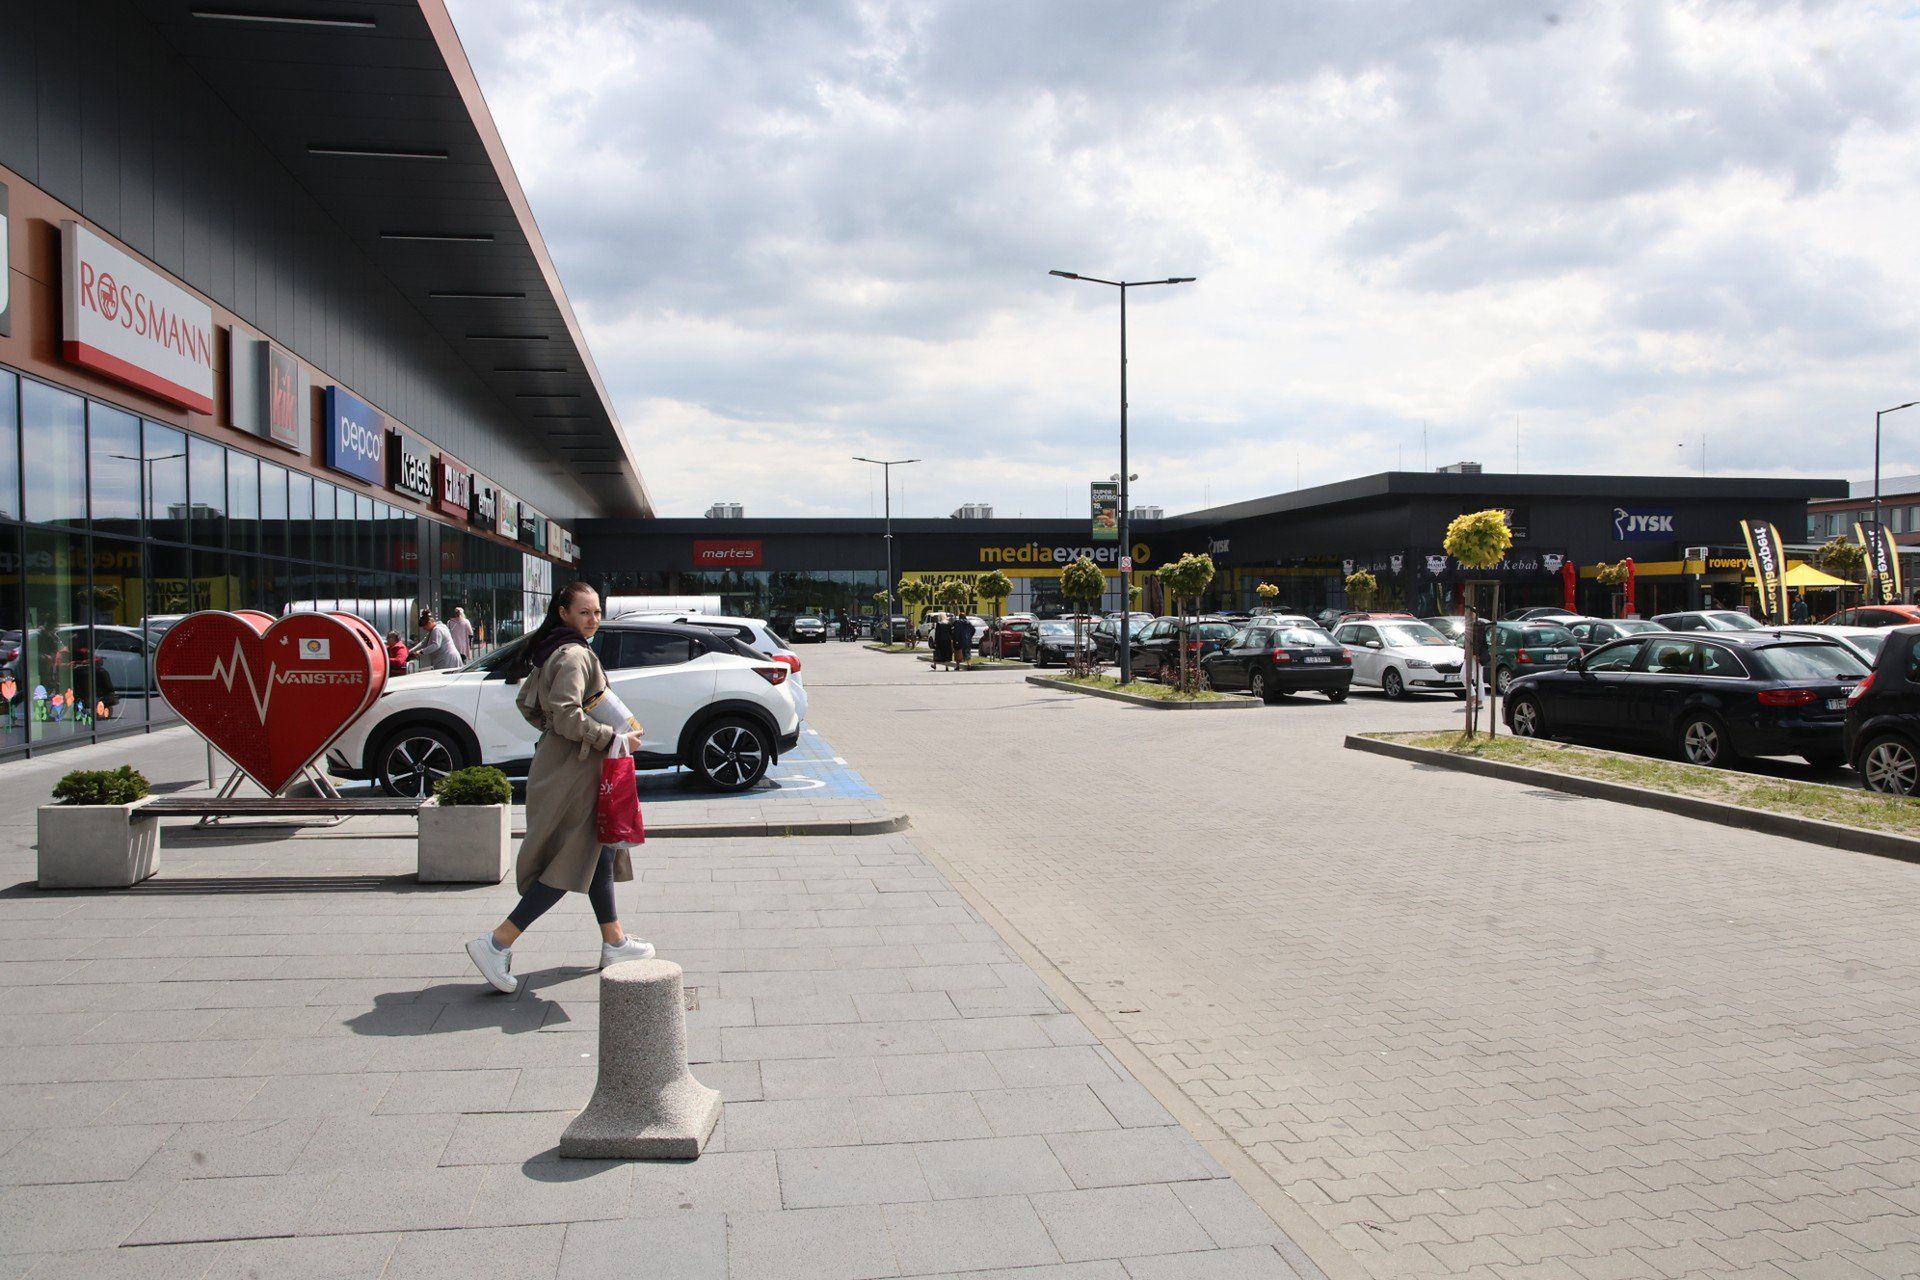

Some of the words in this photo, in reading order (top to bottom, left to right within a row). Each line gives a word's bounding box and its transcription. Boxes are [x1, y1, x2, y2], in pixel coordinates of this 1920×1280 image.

[80, 260, 211, 369] ROSSMANN
[1627, 515, 1675, 532] JYSK
[702, 548, 754, 558] martes
[1503, 560, 1539, 570] Kebab
[275, 670, 363, 684] VANSTAR
